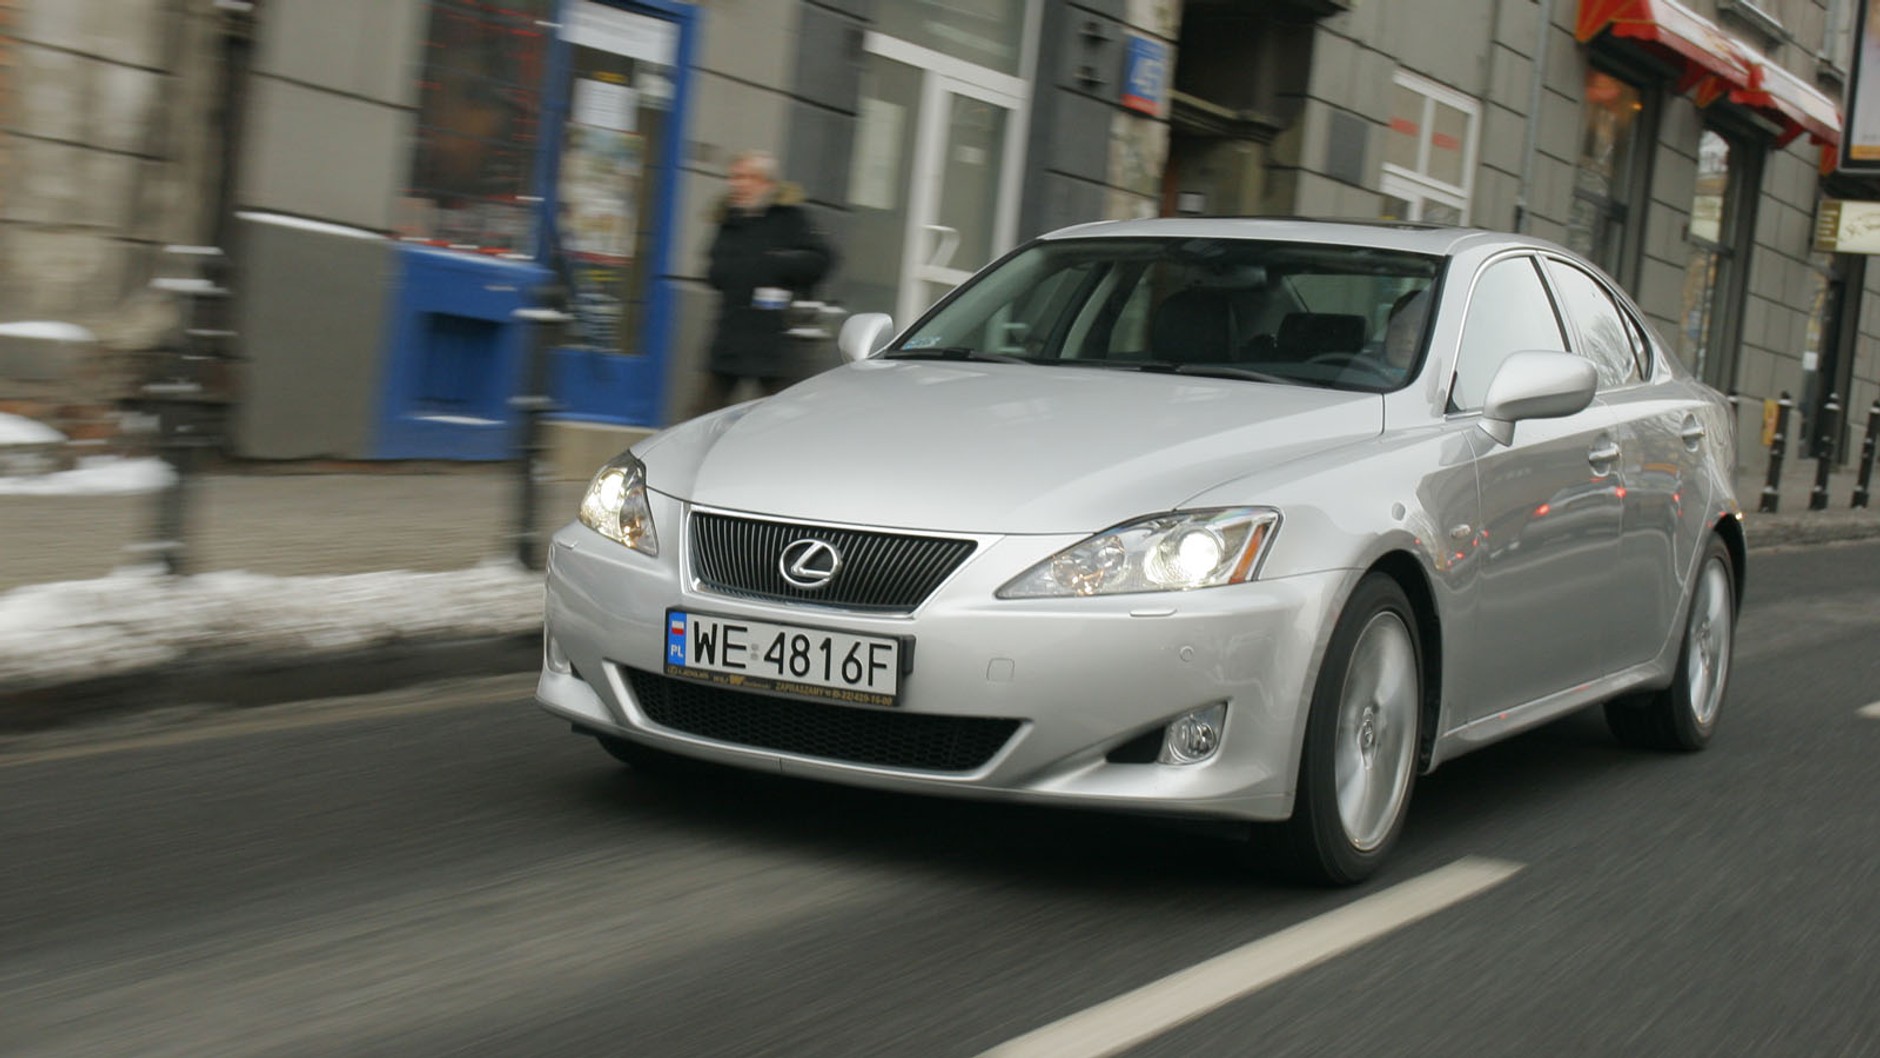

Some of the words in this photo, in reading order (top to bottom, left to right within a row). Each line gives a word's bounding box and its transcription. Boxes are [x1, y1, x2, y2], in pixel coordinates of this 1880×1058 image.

[671, 644, 684, 658] PL
[694, 621, 748, 669] WE
[763, 632, 892, 687] 4816F
